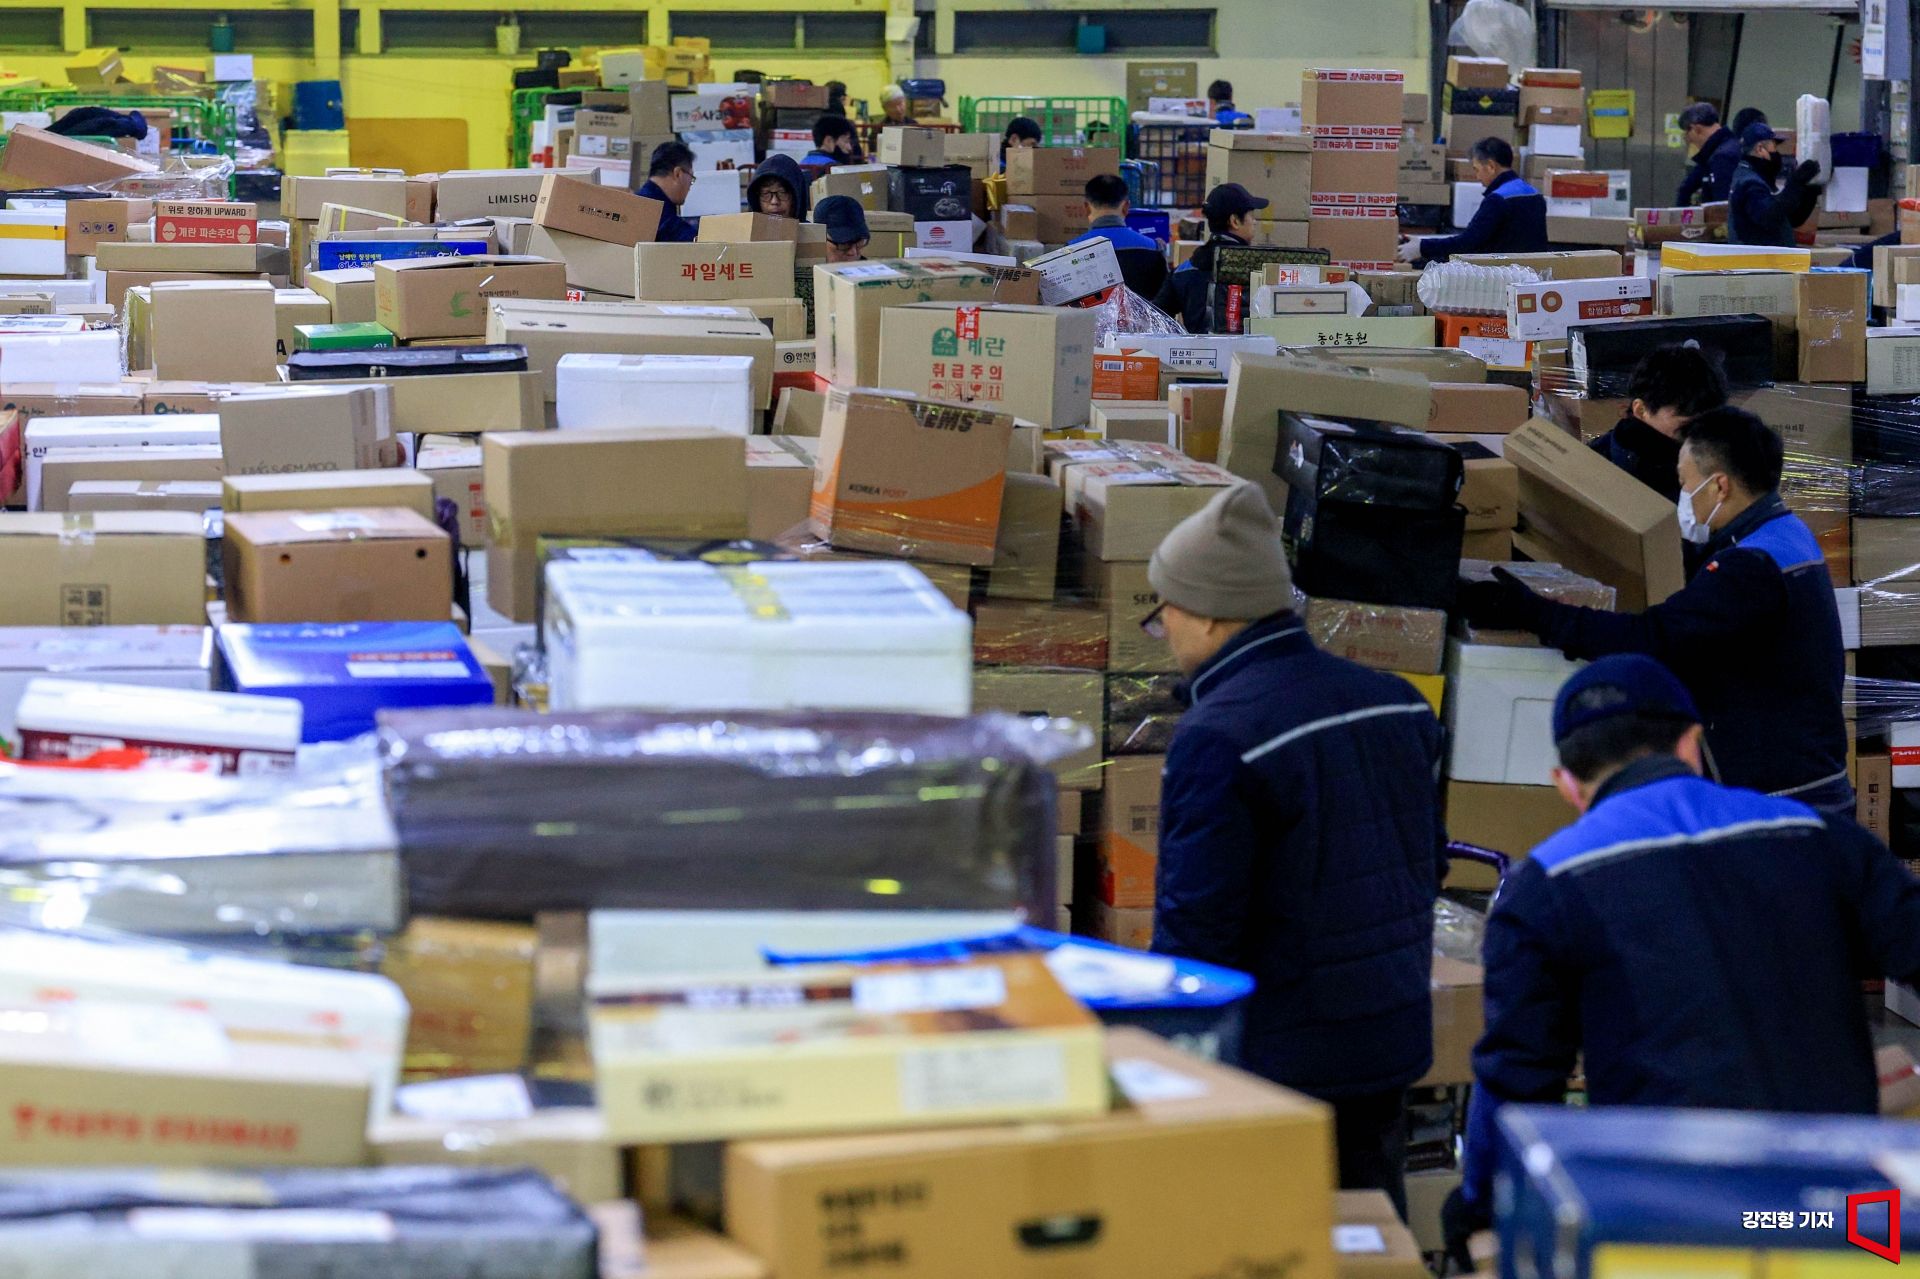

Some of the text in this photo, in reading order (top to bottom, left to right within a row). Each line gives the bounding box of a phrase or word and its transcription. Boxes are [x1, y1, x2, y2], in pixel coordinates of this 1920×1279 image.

[1360, 127, 1385, 136] 취급주의
[488, 194, 538, 204] LIMISHO
[1312, 194, 1336, 203] 취급주의
[168, 205, 246, 217] 위로 향하게 UPWARD
[199, 228, 235, 240] 파손주의
[681, 262, 755, 281] 과일세트
[1350, 262, 1375, 271] 취급주의
[1317, 332, 1368, 345] 동양농원
[848, 483, 909, 498] KOREA POST
